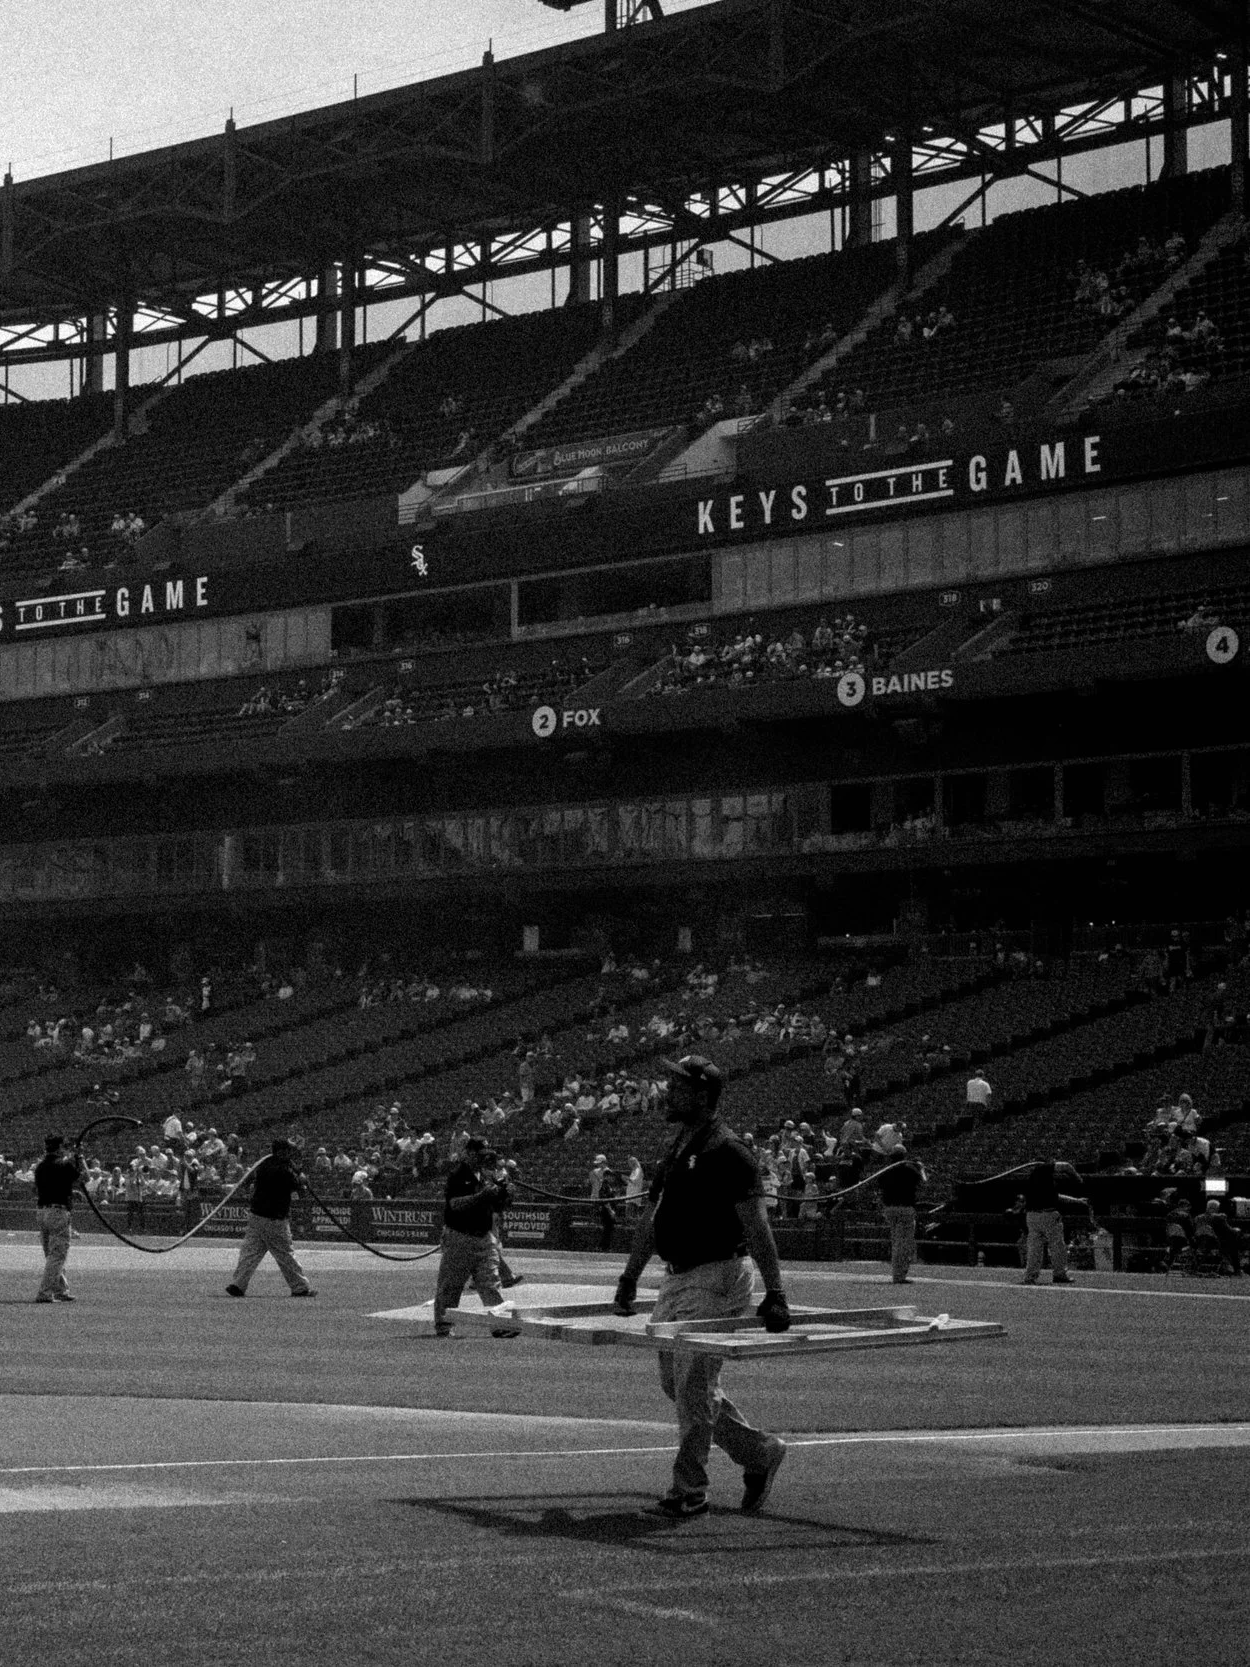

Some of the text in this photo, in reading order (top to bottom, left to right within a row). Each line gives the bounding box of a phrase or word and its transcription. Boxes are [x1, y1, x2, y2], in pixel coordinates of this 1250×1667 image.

[697, 435, 1101, 534] KEYS TO THE GAME
[19, 605, 43, 623] TO
[59, 596, 103, 617] THE
[116, 576, 209, 616] GAME
[871, 669, 954, 696] BAINES
[562, 708, 601, 728] FOX
[371, 1206, 435, 1223] WINTRUST
[502, 1211, 550, 1221] SOUTHSIDE
